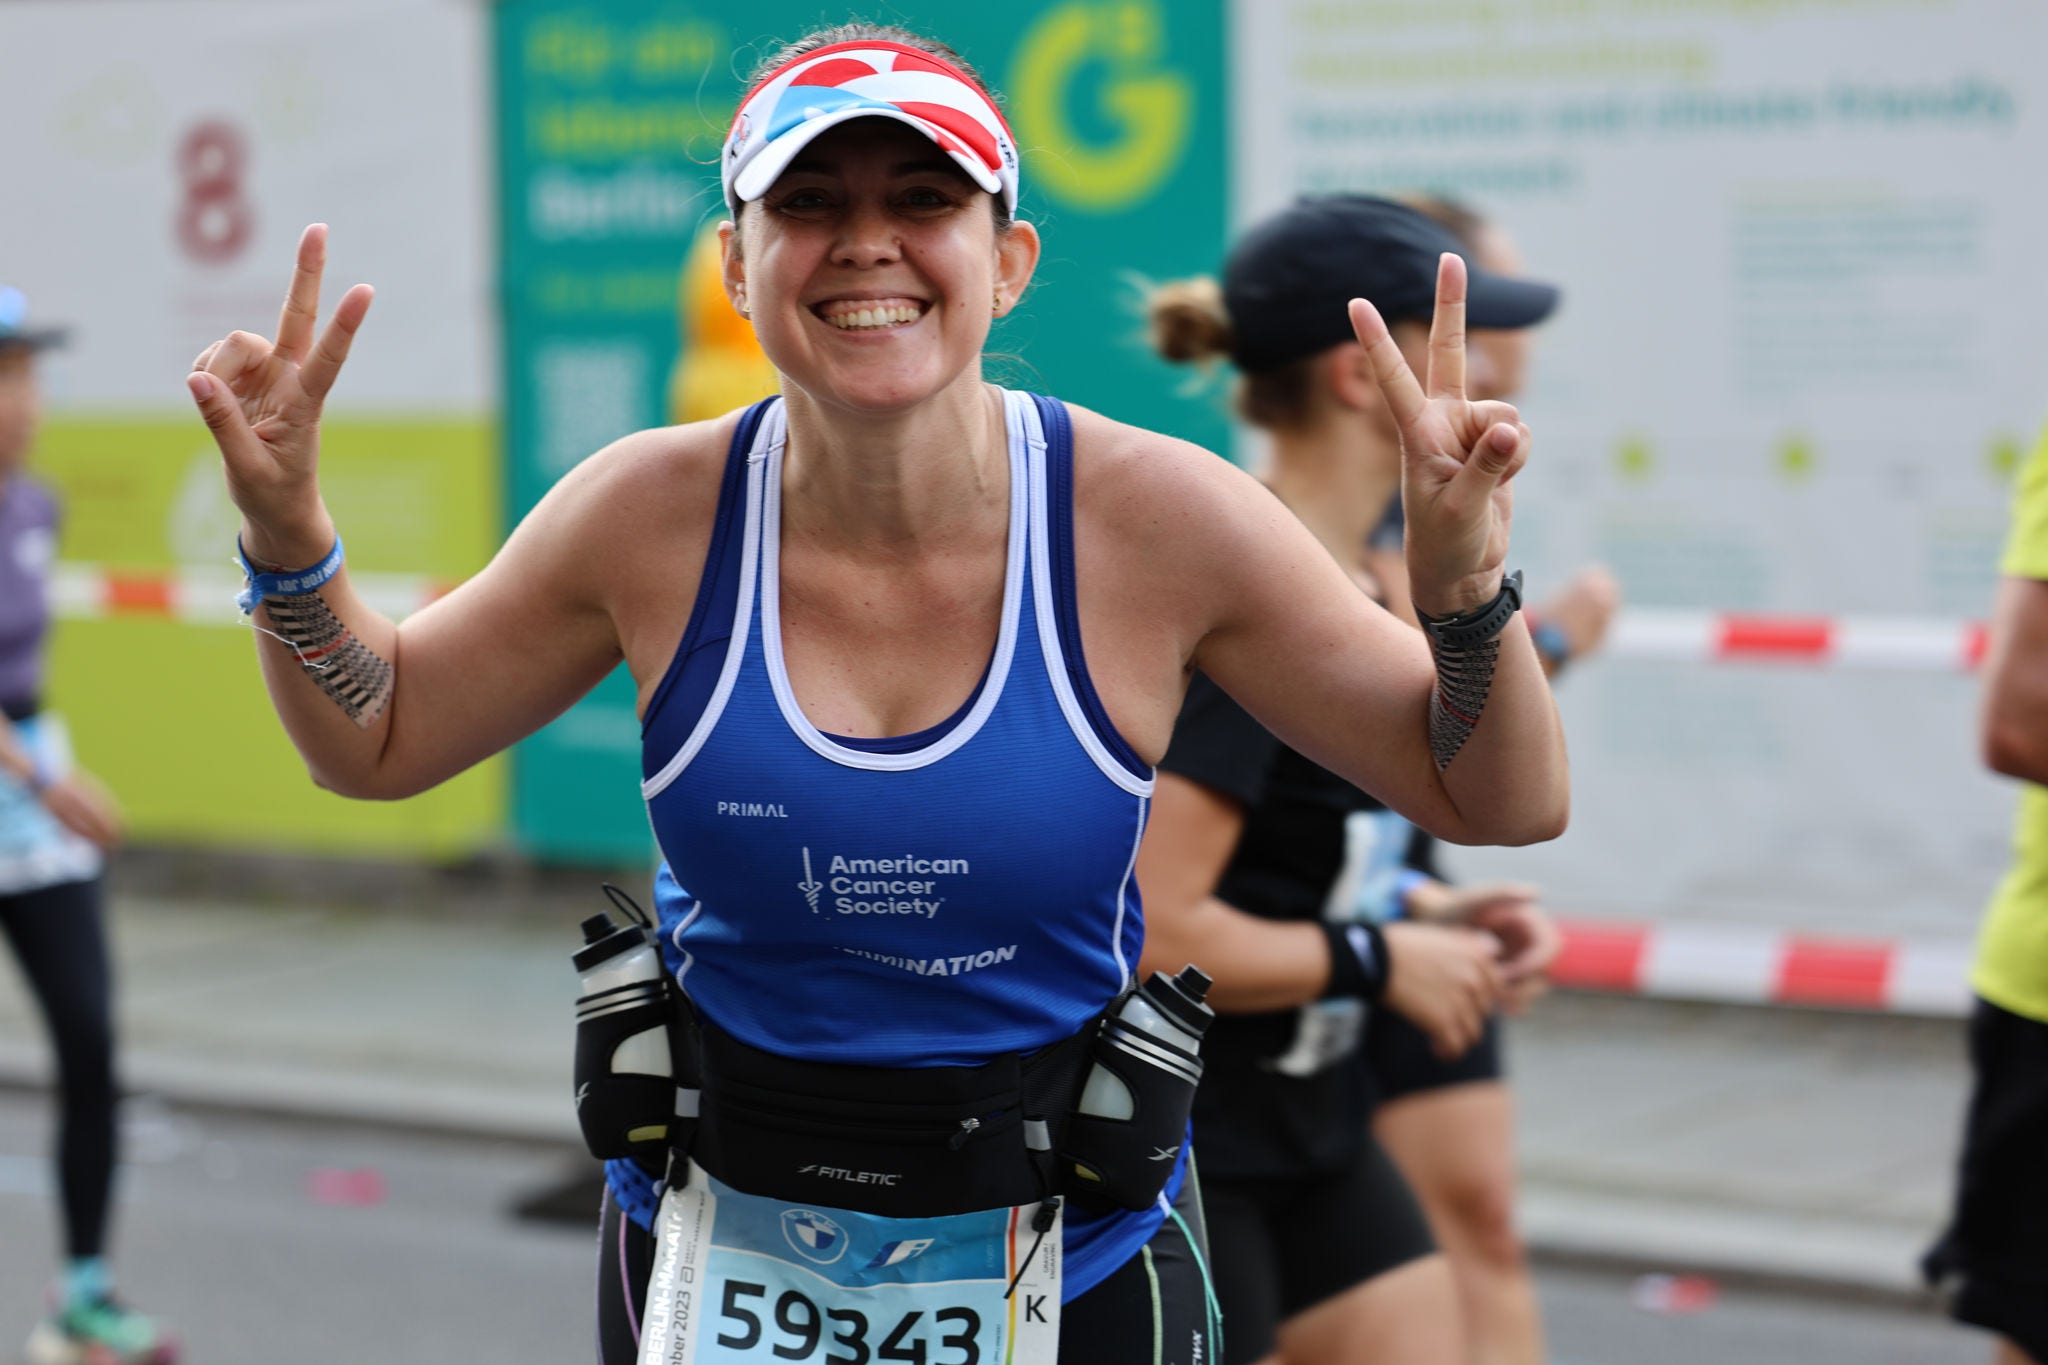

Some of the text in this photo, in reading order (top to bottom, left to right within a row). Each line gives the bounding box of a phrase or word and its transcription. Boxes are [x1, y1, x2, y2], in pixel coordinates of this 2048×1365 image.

[174, 119, 256, 266] 8
[276, 579, 299, 592] JOY
[300, 571, 324, 589] FOR
[717, 801, 789, 818] PRIMAL
[829, 854, 969, 875] American
[830, 877, 936, 895] Cancer
[835, 897, 941, 919] Society
[818, 1165, 898, 1187] FITLETIC
[673, 1291, 691, 1331] 2023
[1025, 1294, 1048, 1323] K
[716, 1278, 982, 1365] 59343
